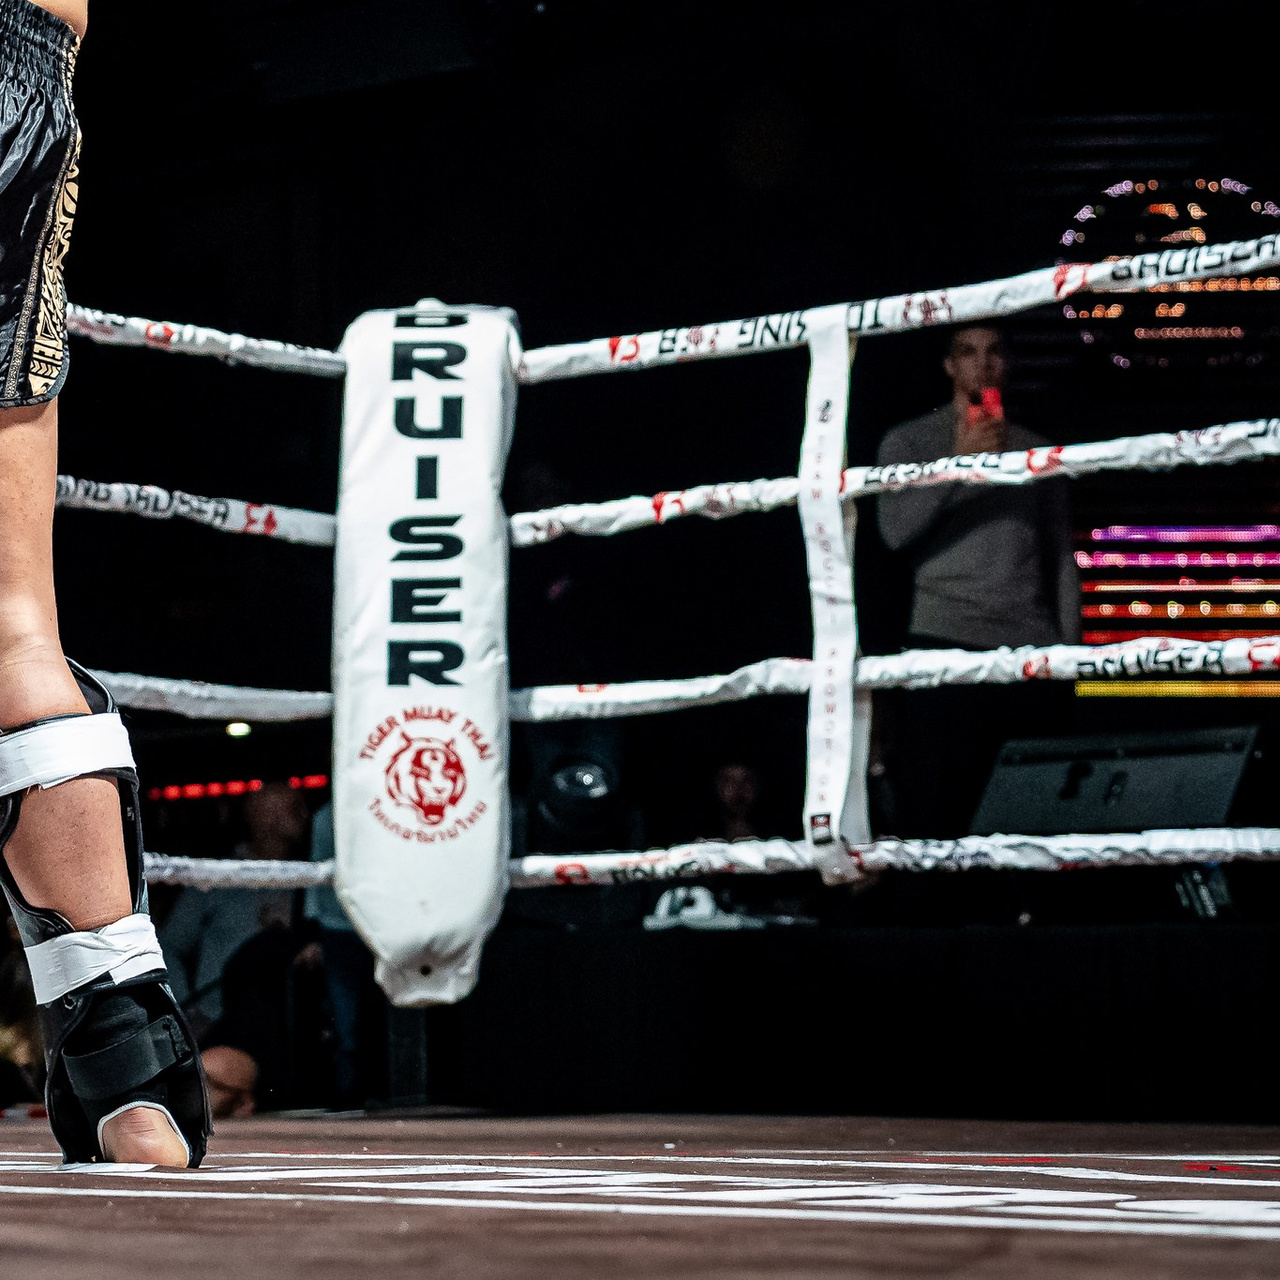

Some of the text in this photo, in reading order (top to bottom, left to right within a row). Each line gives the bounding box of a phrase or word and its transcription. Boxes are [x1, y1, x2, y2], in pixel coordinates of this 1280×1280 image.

[358, 705, 496, 762] TIGER MUAY THAI
